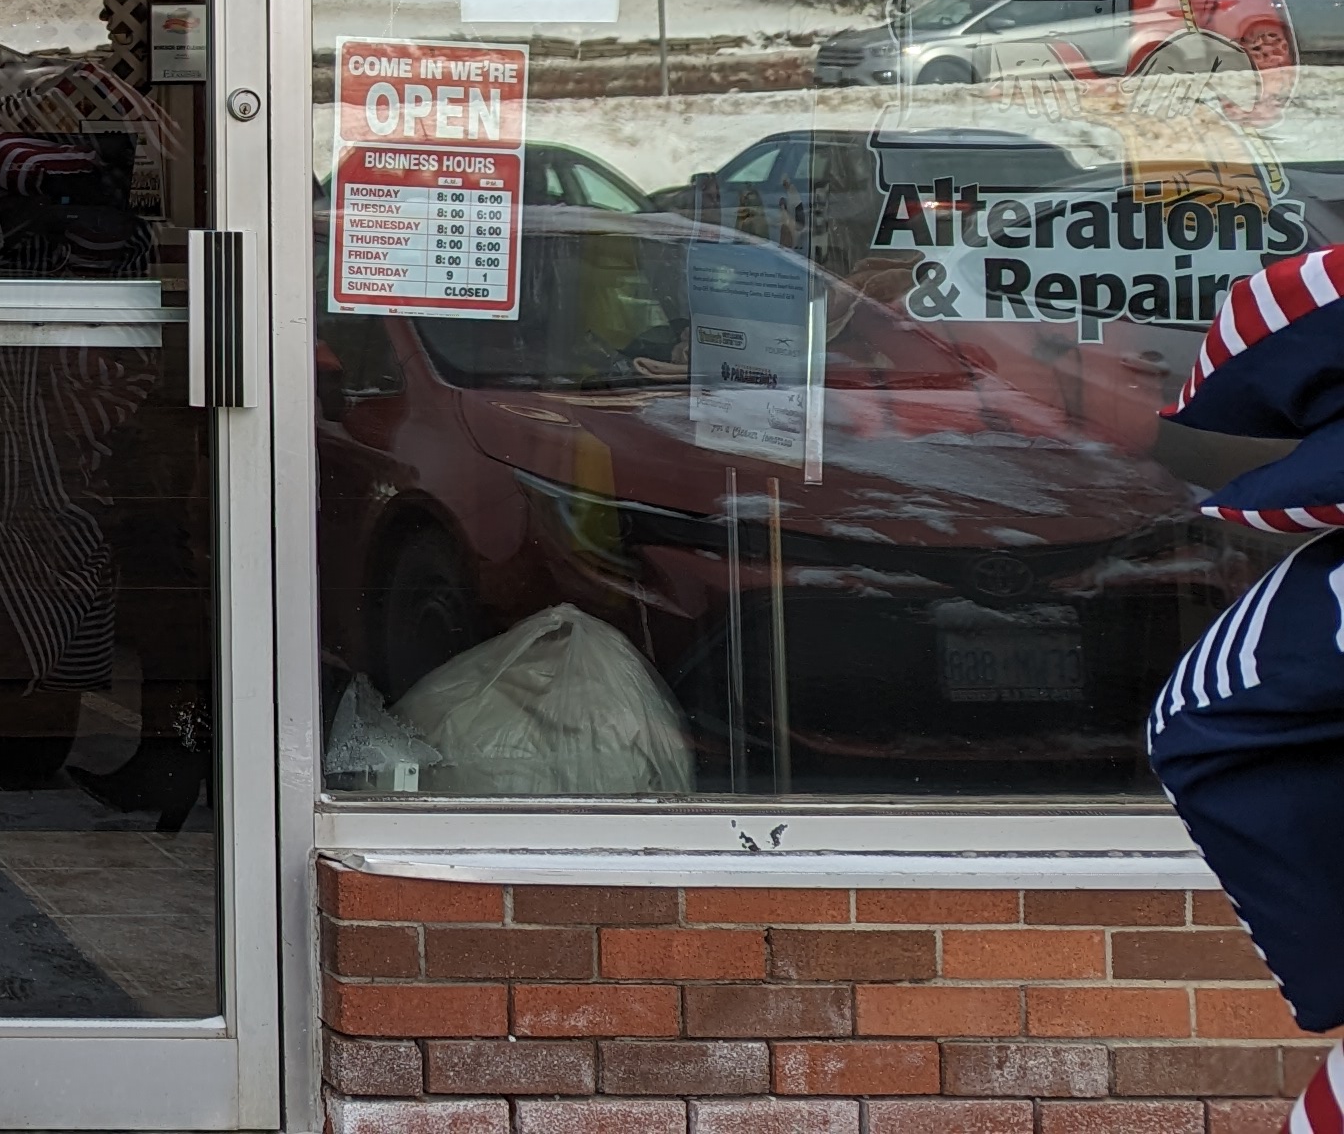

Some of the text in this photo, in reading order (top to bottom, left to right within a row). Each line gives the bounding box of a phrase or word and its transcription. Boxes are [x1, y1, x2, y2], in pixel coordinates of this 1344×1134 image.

[348, 56, 518, 83] COME IN WE'RE
[366, 82, 501, 140] OPEN
[365, 152, 495, 173] BUSINESS HOURS
[350, 187, 400, 198] MONDAY
[350, 203, 401, 215] TUESDAY
[873, 177, 1305, 253] Alterations
[349, 219, 420, 231] WEDNESDAY
[349, 234, 410, 246] THURSDAY
[348, 250, 388, 261] FRIDAY
[348, 266, 487, 282] SATURDAY 9 1
[348, 281, 489, 298] SUNDAY CLOSED
[909, 254, 1253, 341] & Repair
